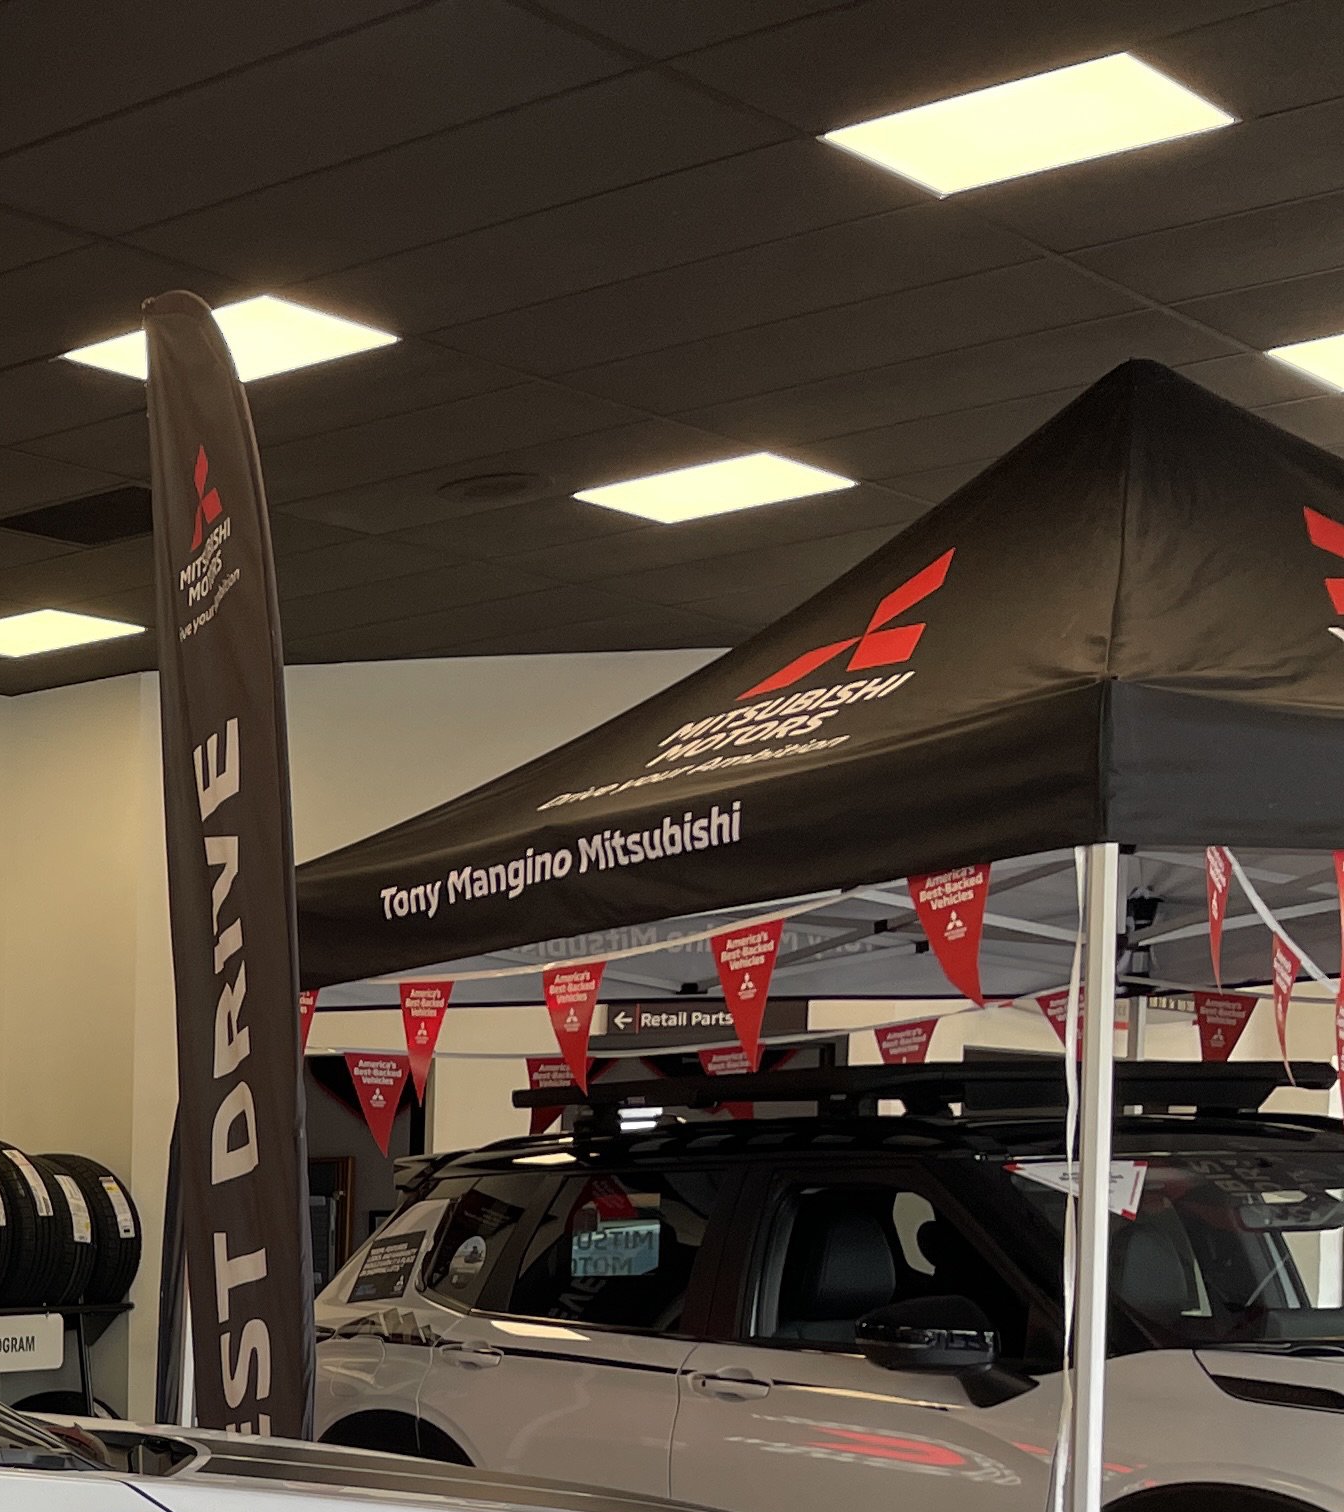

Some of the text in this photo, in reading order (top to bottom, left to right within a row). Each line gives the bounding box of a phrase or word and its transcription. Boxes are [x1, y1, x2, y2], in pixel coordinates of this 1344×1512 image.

[645, 709, 839, 768] MOTORS
[658, 670, 916, 748] MITSUBISHI
[380, 800, 742, 920] Tony Mangino Mitsubishi
[919, 872, 984, 903] Best-Backed
[930, 889, 975, 911] Vehicles
[192, 717, 260, 1187] DRIVE
[641, 1011, 734, 1028] Retail Parts
